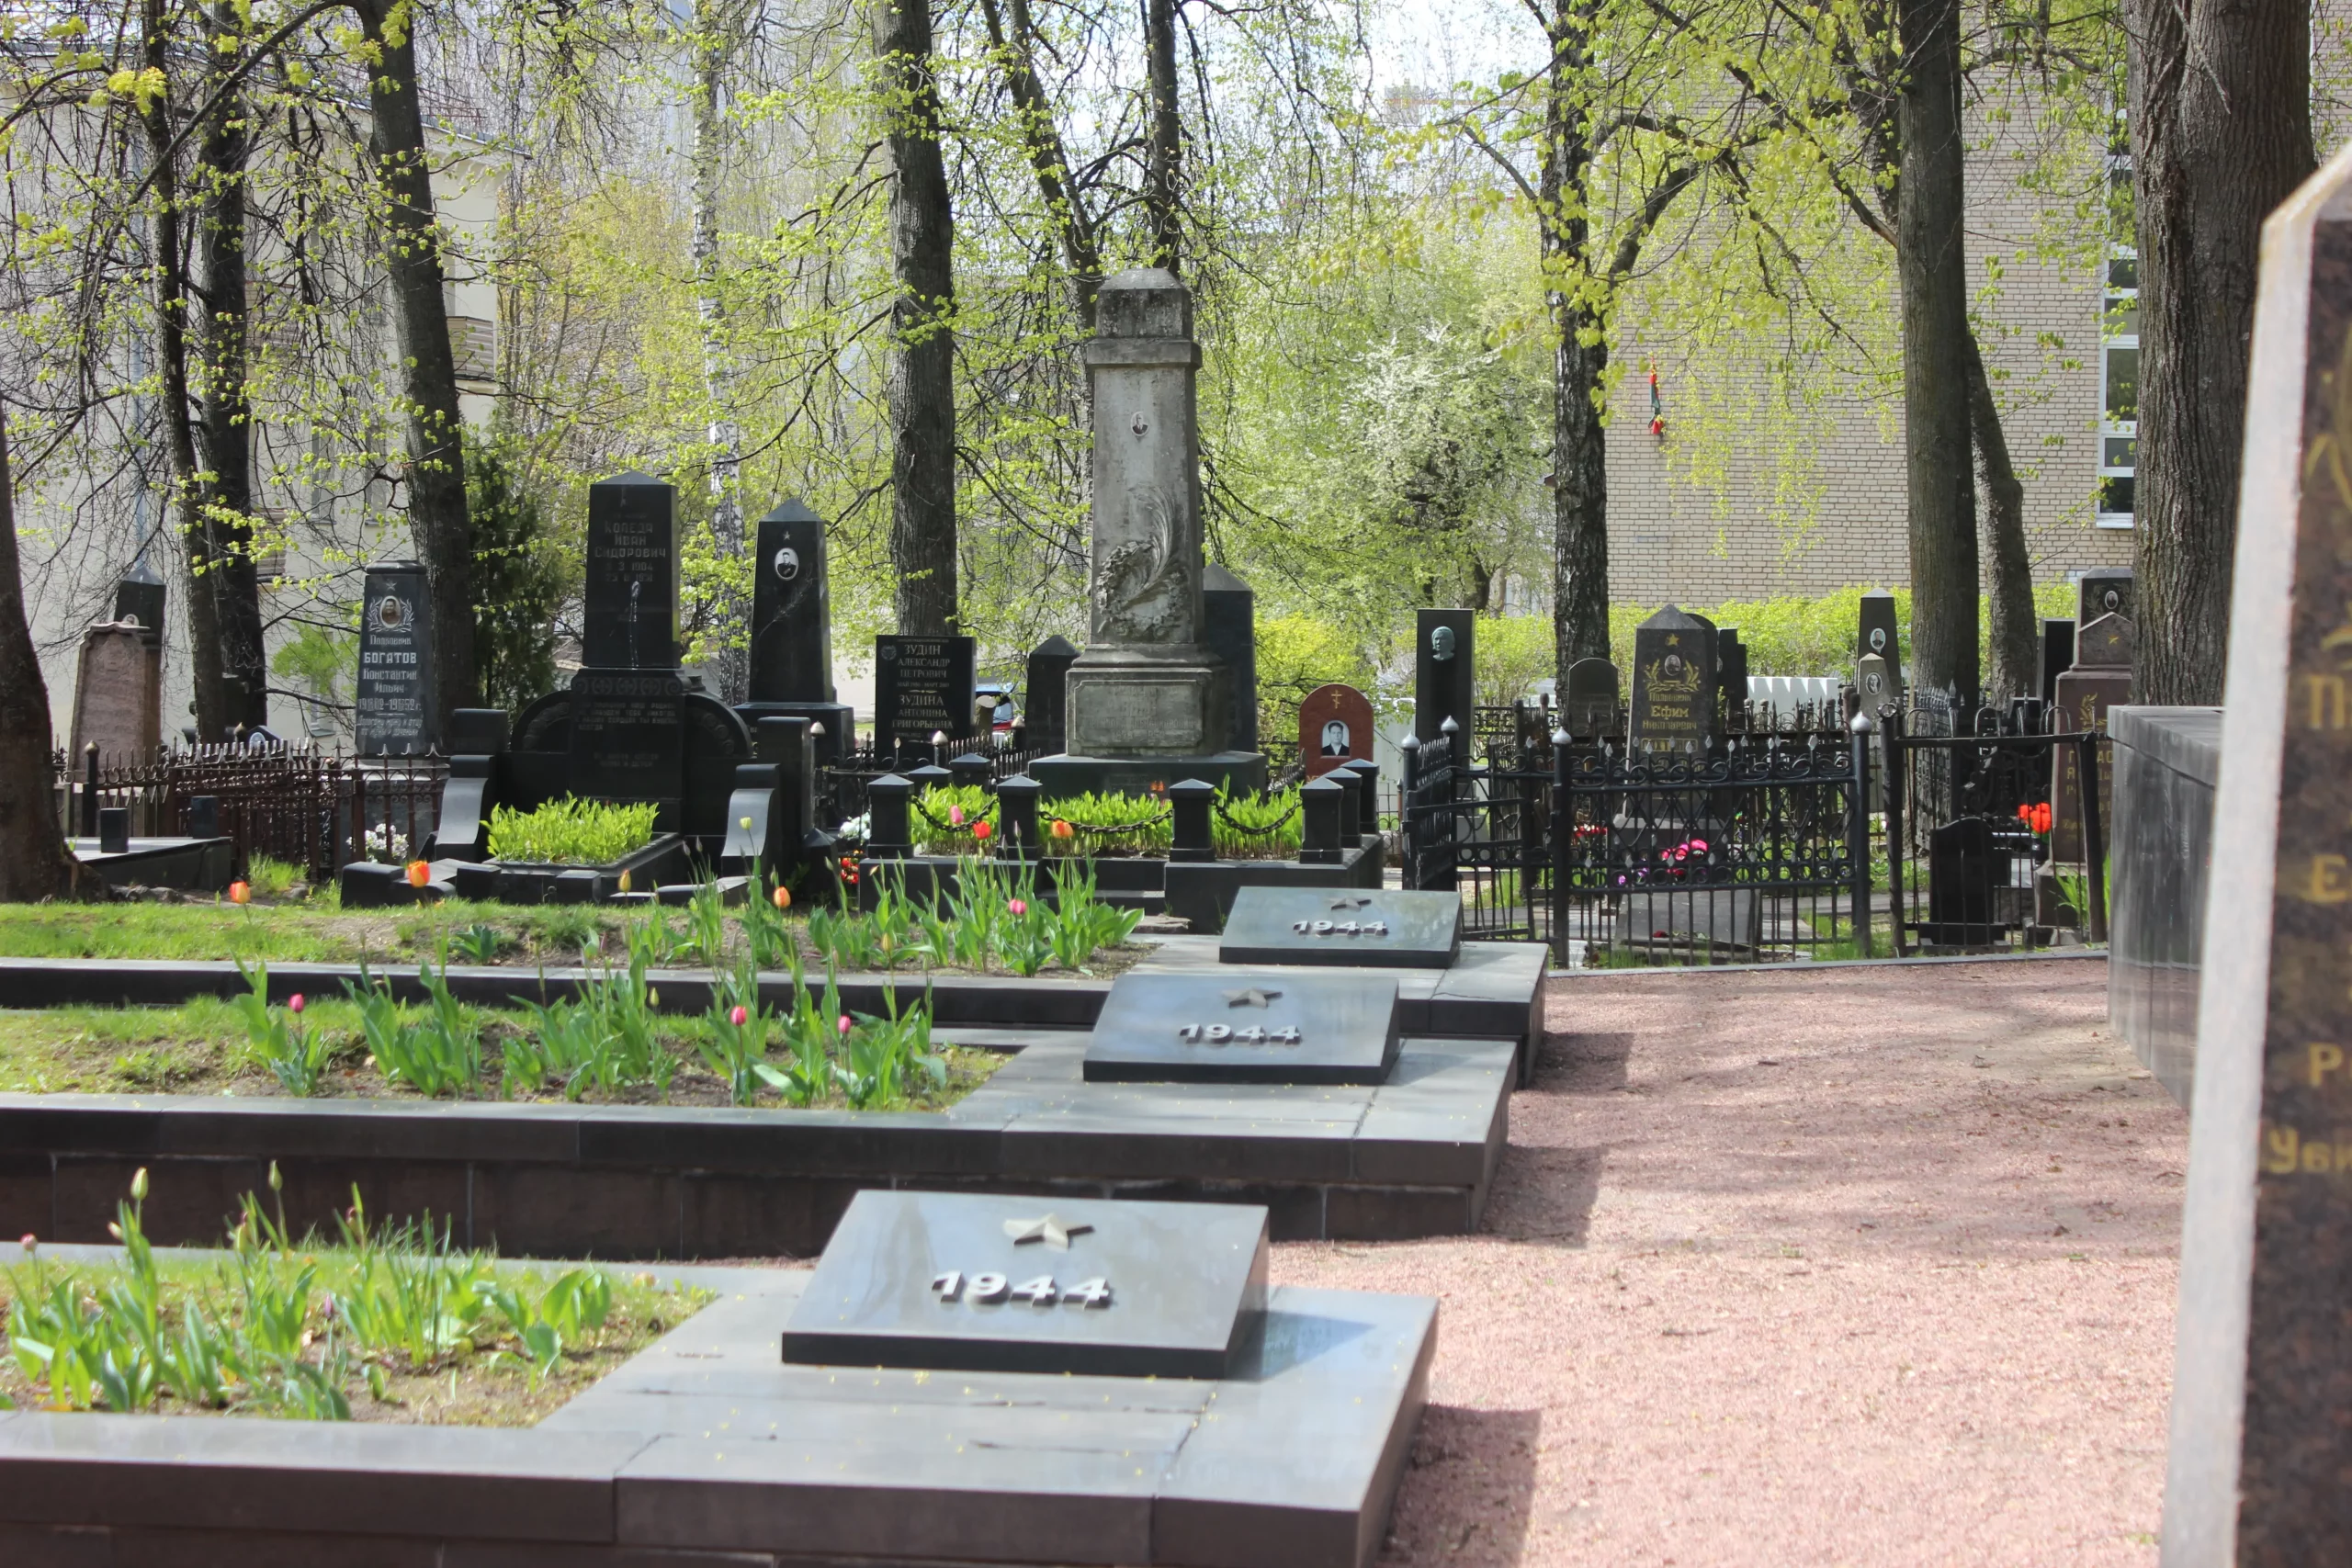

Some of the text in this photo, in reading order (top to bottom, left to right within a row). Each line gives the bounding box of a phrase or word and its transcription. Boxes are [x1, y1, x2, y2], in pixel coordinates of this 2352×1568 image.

[904, 644, 941, 656] ЗУДИН
[364, 651, 417, 663] БОГАТОВ
[898, 658, 950, 668] АЛЕКСАНДР
[363, 667, 417, 680] Константин
[900, 669, 947, 679] ПЕТРОВИЧ
[374, 682, 404, 693] Ильич
[899, 694, 944, 706] ЗУДИНА
[898, 708, 947, 717] АНТОНИНА
[1650, 705, 1690, 720] Ефим
[892, 719, 954, 729] ГРИГОРЬЕВНА
[1293, 920, 1388, 936] 1944
[1179, 1023, 1302, 1044] 1944
[931, 1270, 1113, 1309] 1944
